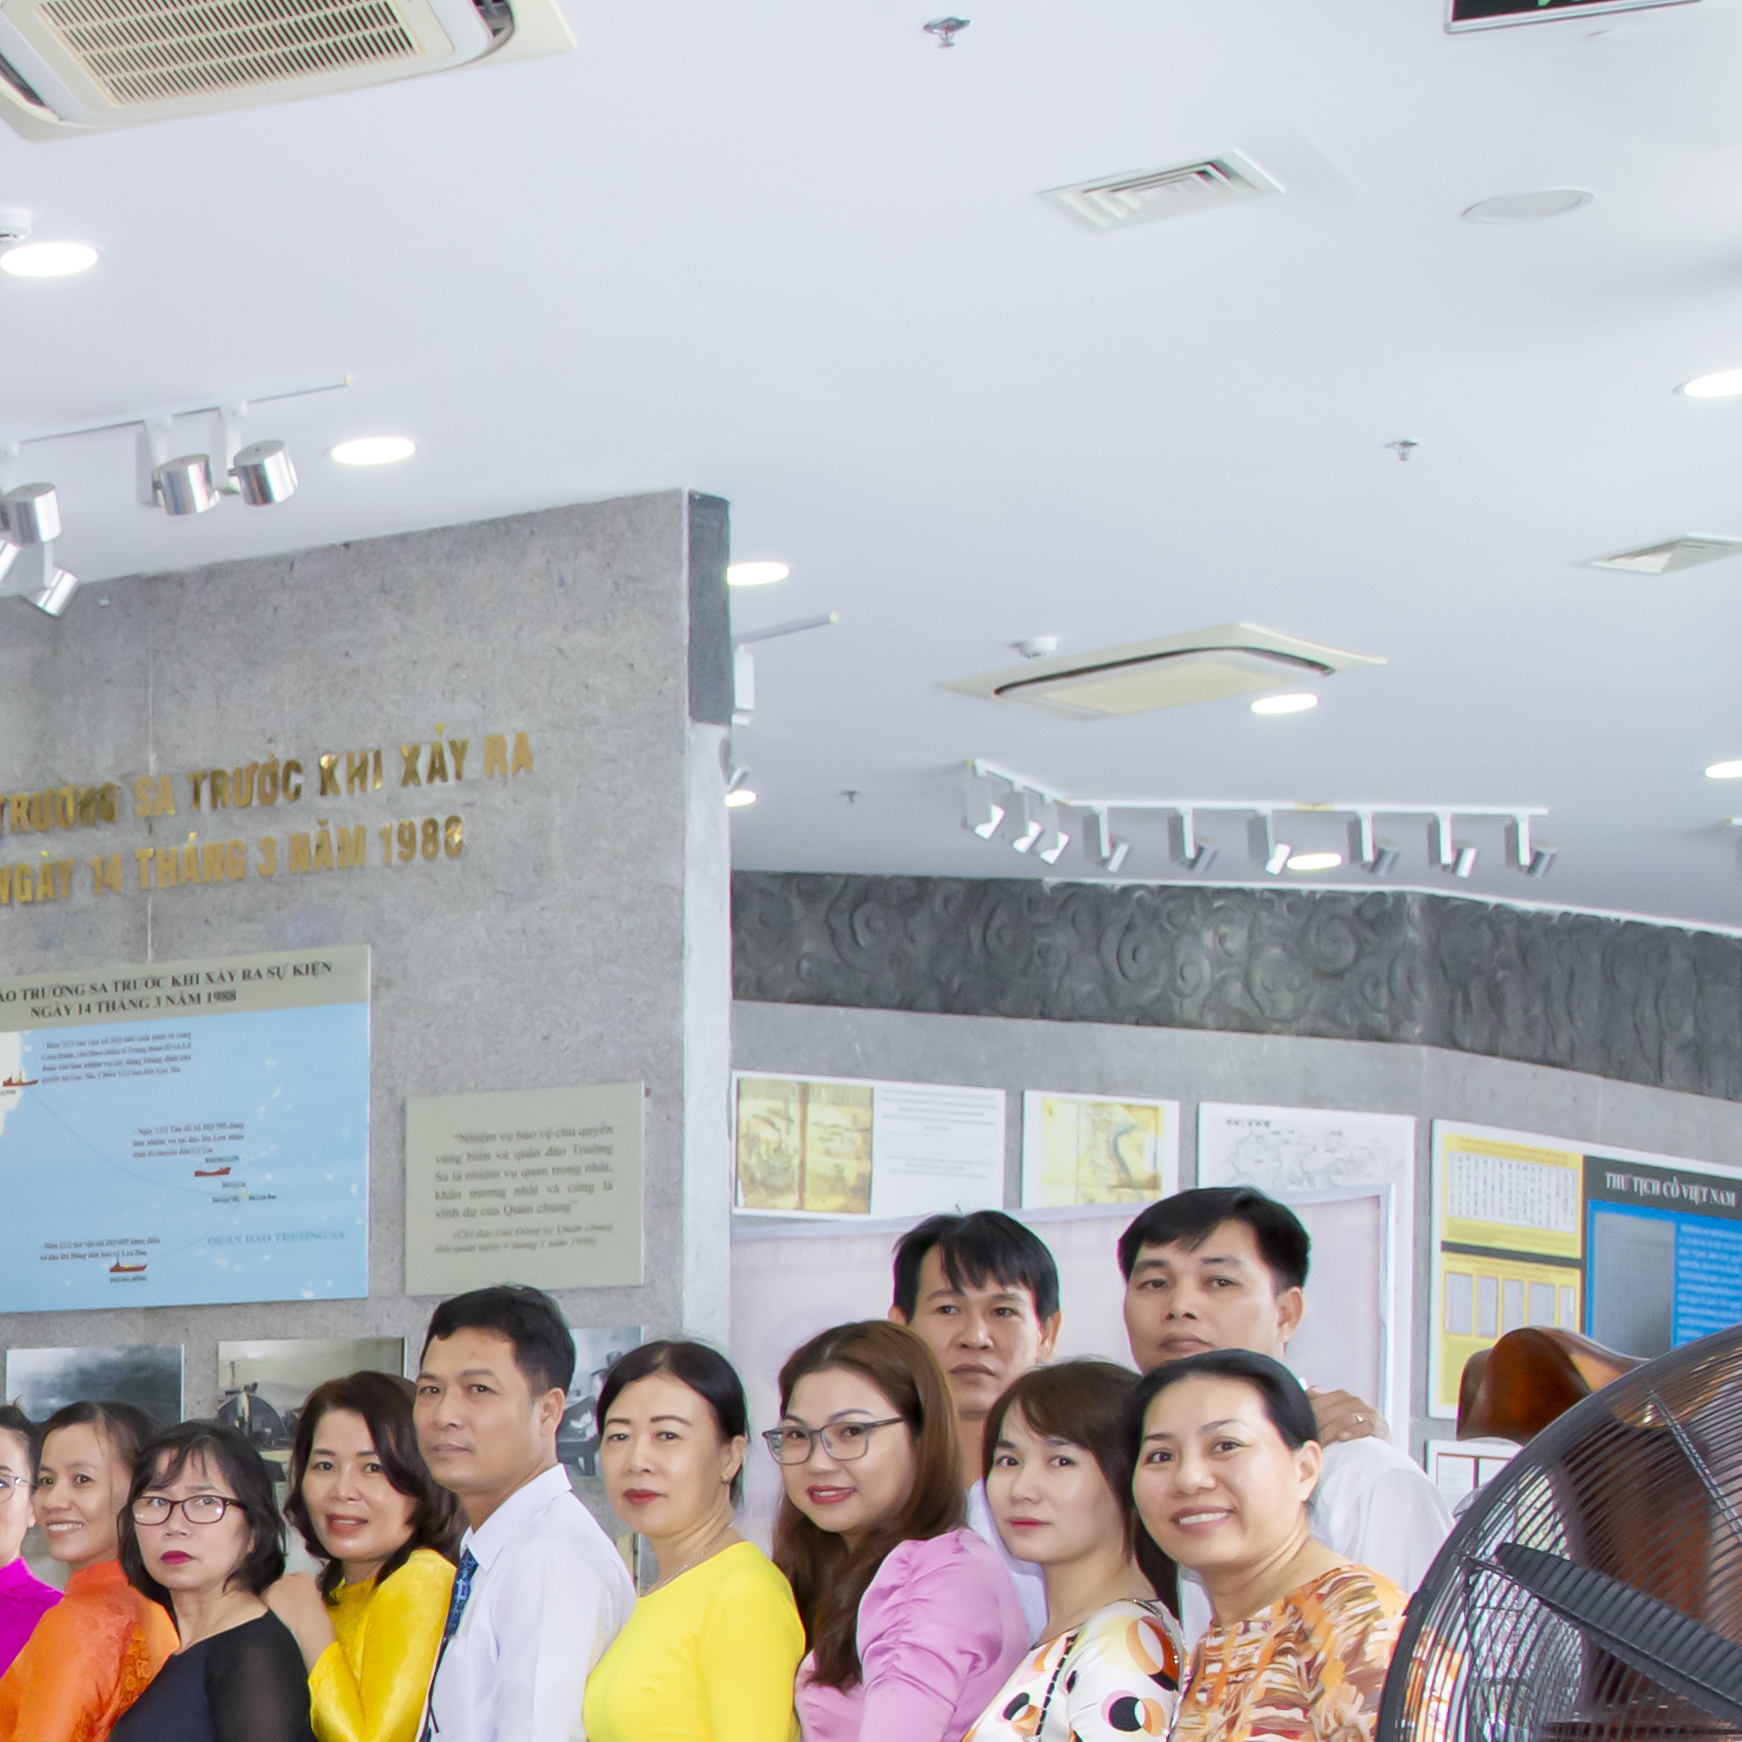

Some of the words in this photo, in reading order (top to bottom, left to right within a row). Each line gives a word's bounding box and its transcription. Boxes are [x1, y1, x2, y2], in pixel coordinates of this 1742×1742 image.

[135, 775, 175, 817] SA
[188, 751, 303, 811] TRƯỚC
[320, 749, 382, 796] KHI
[401, 723, 469, 787] XẢY
[485, 732, 534, 777] RA
[91, 853, 121, 894] 14
[136, 832, 246, 889] THÁNG
[258, 835, 276, 876] 3
[290, 819, 366, 872] NĂM
[1605, 1172, 1630, 1190] THƯ
[1631, 1176, 1660, 1196] TỊCH
[1662, 1176, 1680, 1197] CỔ
[1682, 1185, 1709, 1205] VIỆT
[1710, 1189, 1736, 1207] NAM
